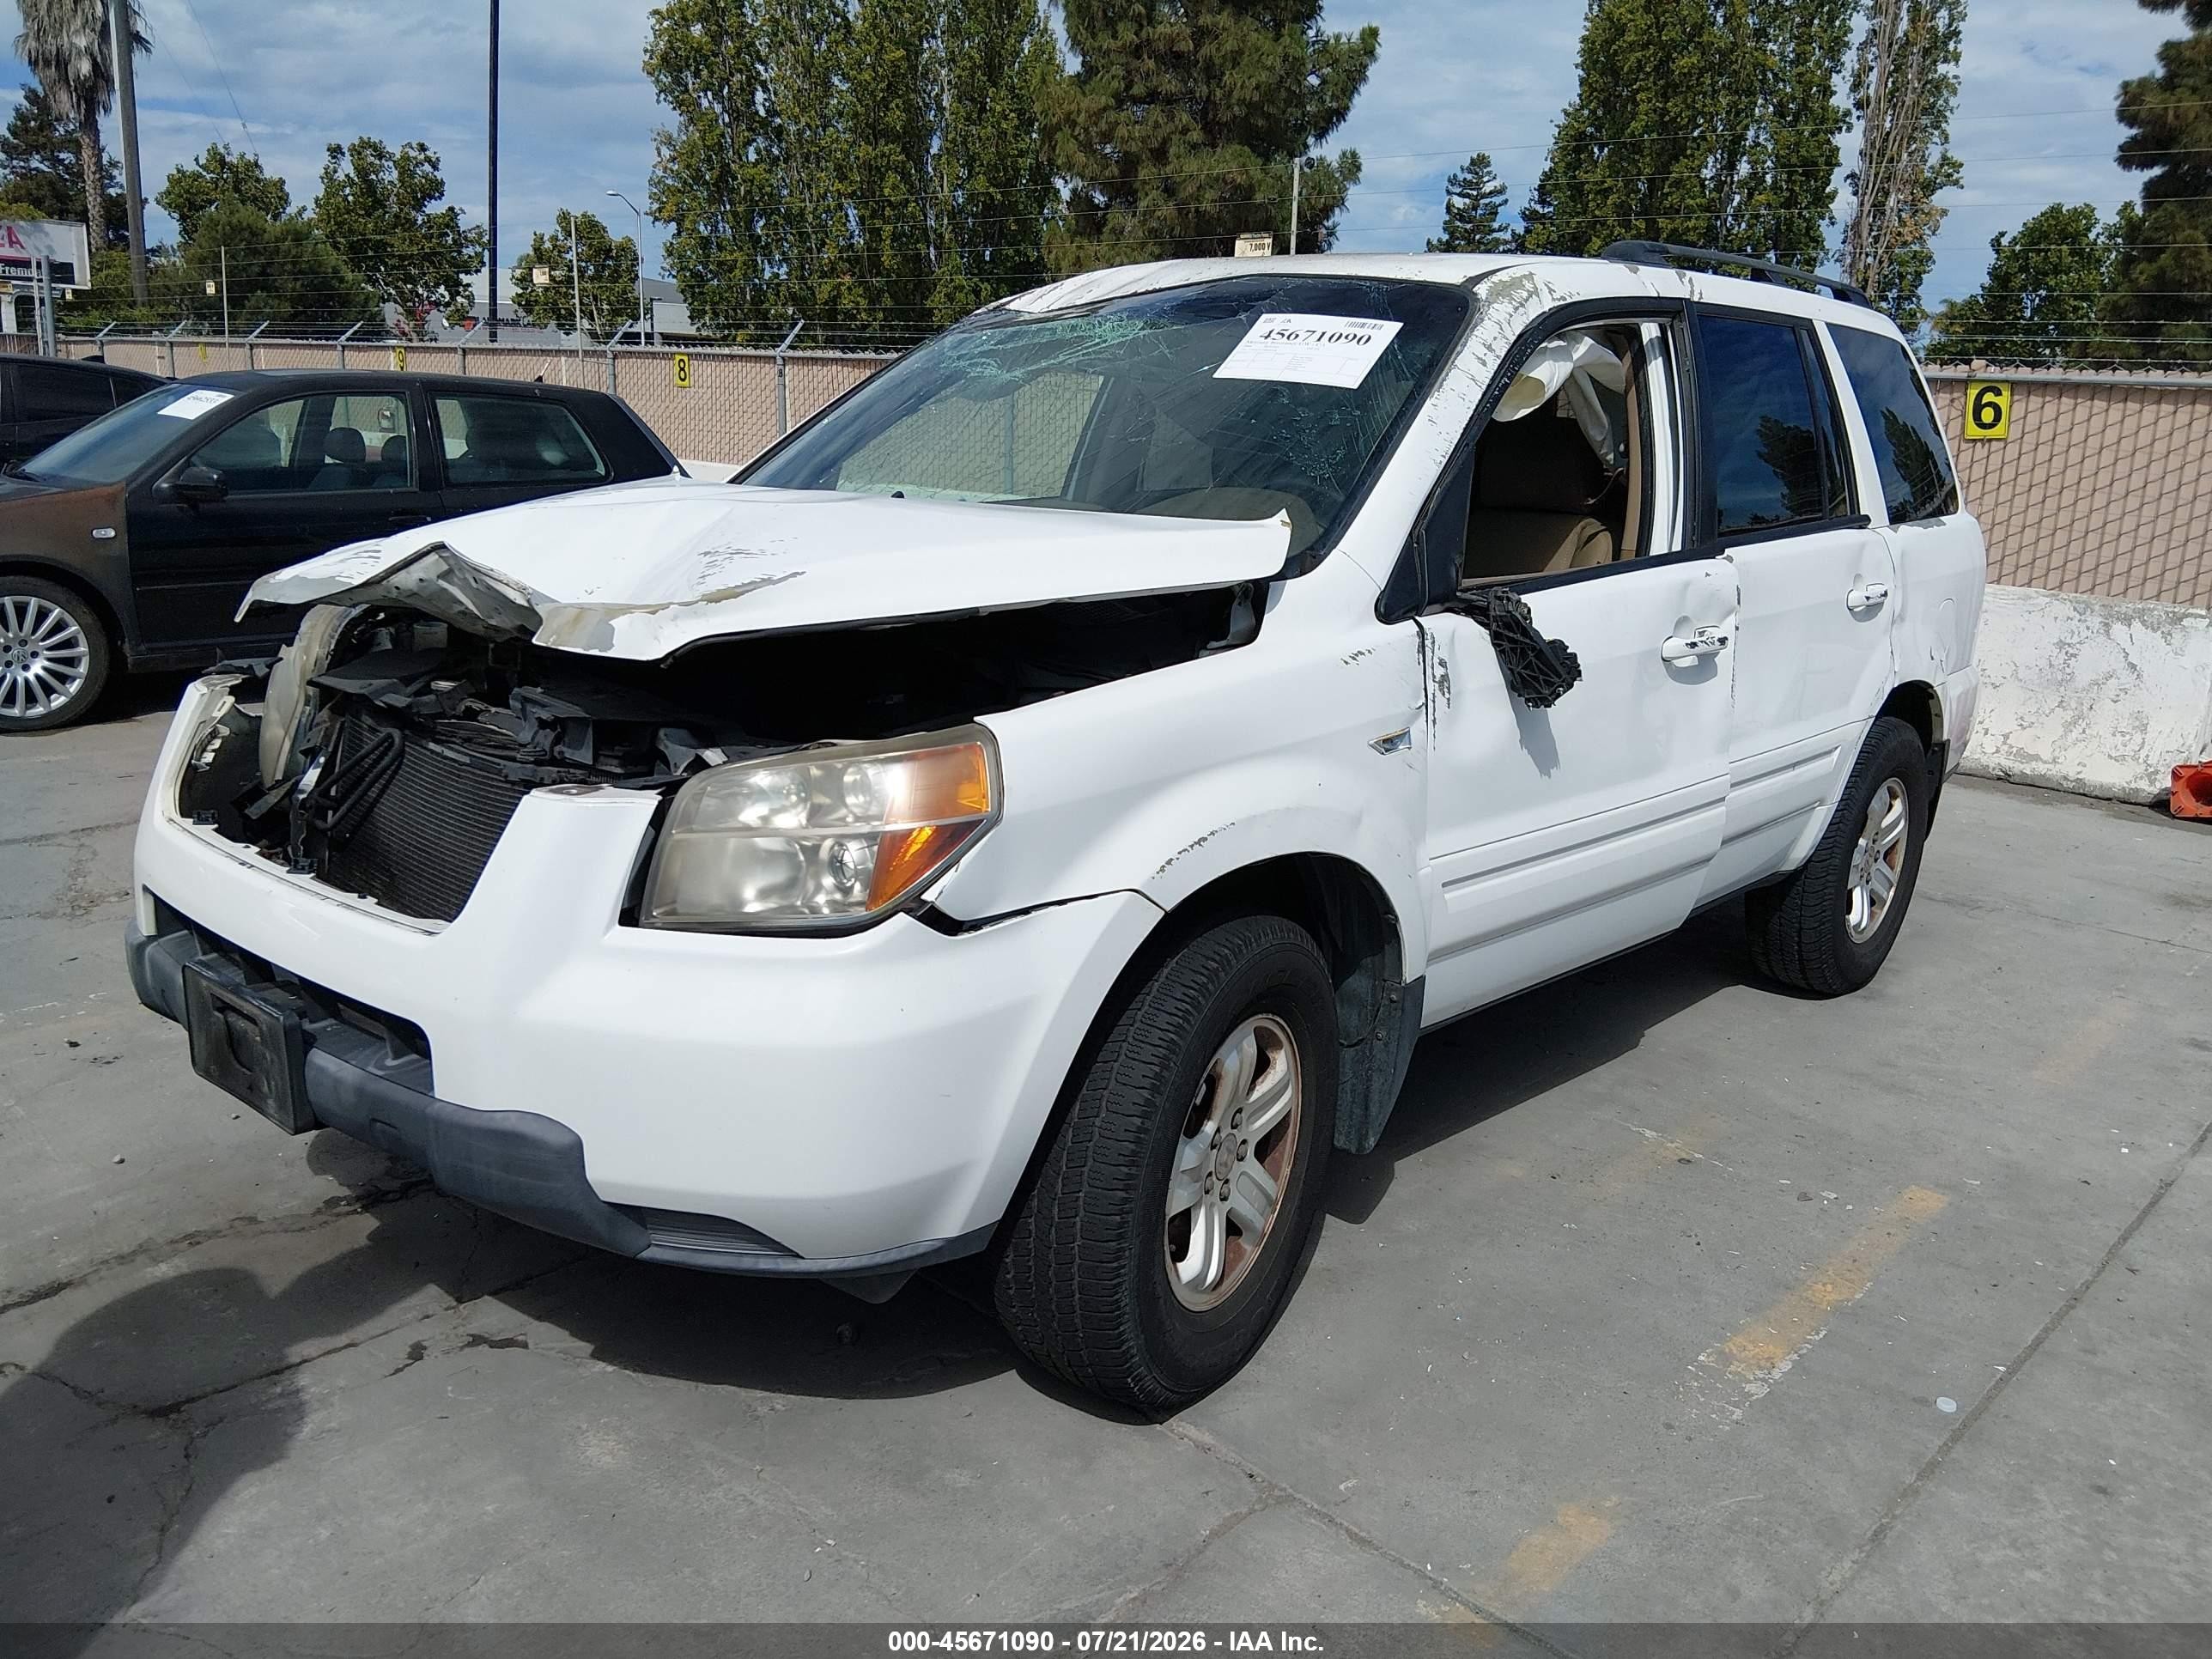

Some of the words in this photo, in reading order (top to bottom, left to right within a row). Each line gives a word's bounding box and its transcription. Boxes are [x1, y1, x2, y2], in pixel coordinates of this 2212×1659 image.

[1249, 243, 1267, 252] 7,000
[1267, 242, 1272, 251] V
[1259, 329, 1372, 346] 45671090
[398, 350, 404, 371] 9
[678, 358, 687, 382] 8
[1972, 385, 2003, 430] 6
